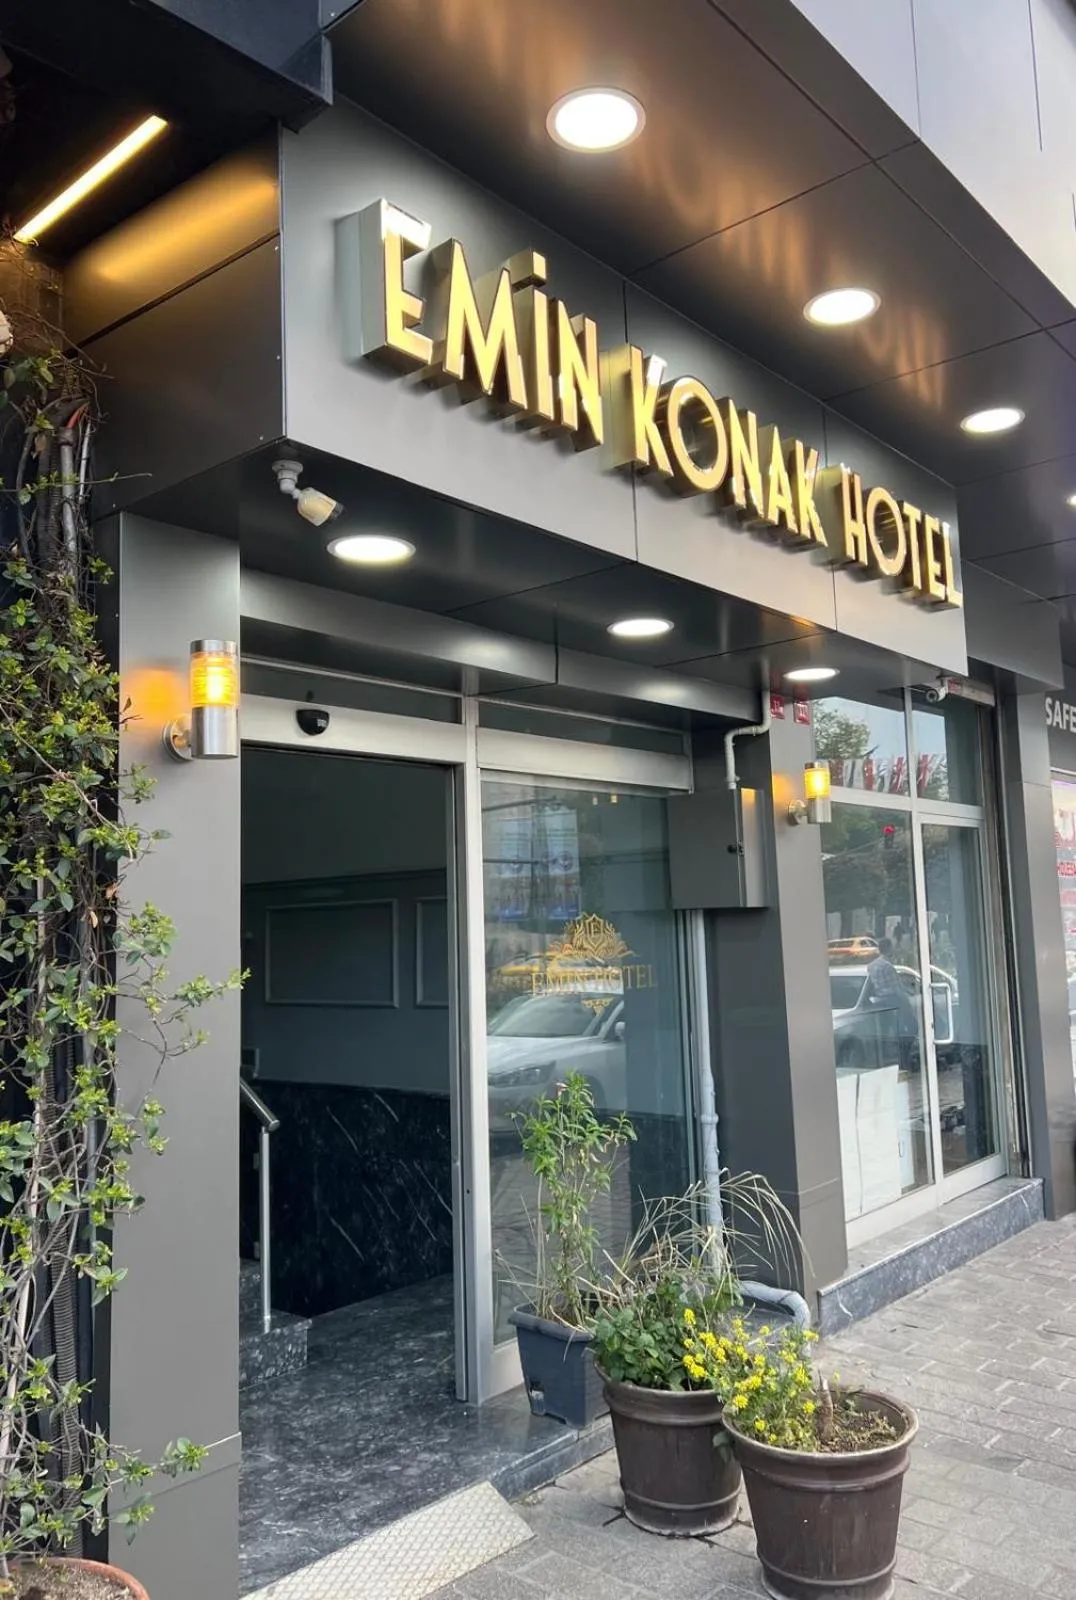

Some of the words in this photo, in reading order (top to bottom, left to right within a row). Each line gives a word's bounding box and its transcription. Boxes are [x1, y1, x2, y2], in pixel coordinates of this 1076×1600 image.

[630, 344, 829, 549] KONAK
[840, 463, 964, 610] HOTEL
[1045, 696, 1076, 733] SAFE
